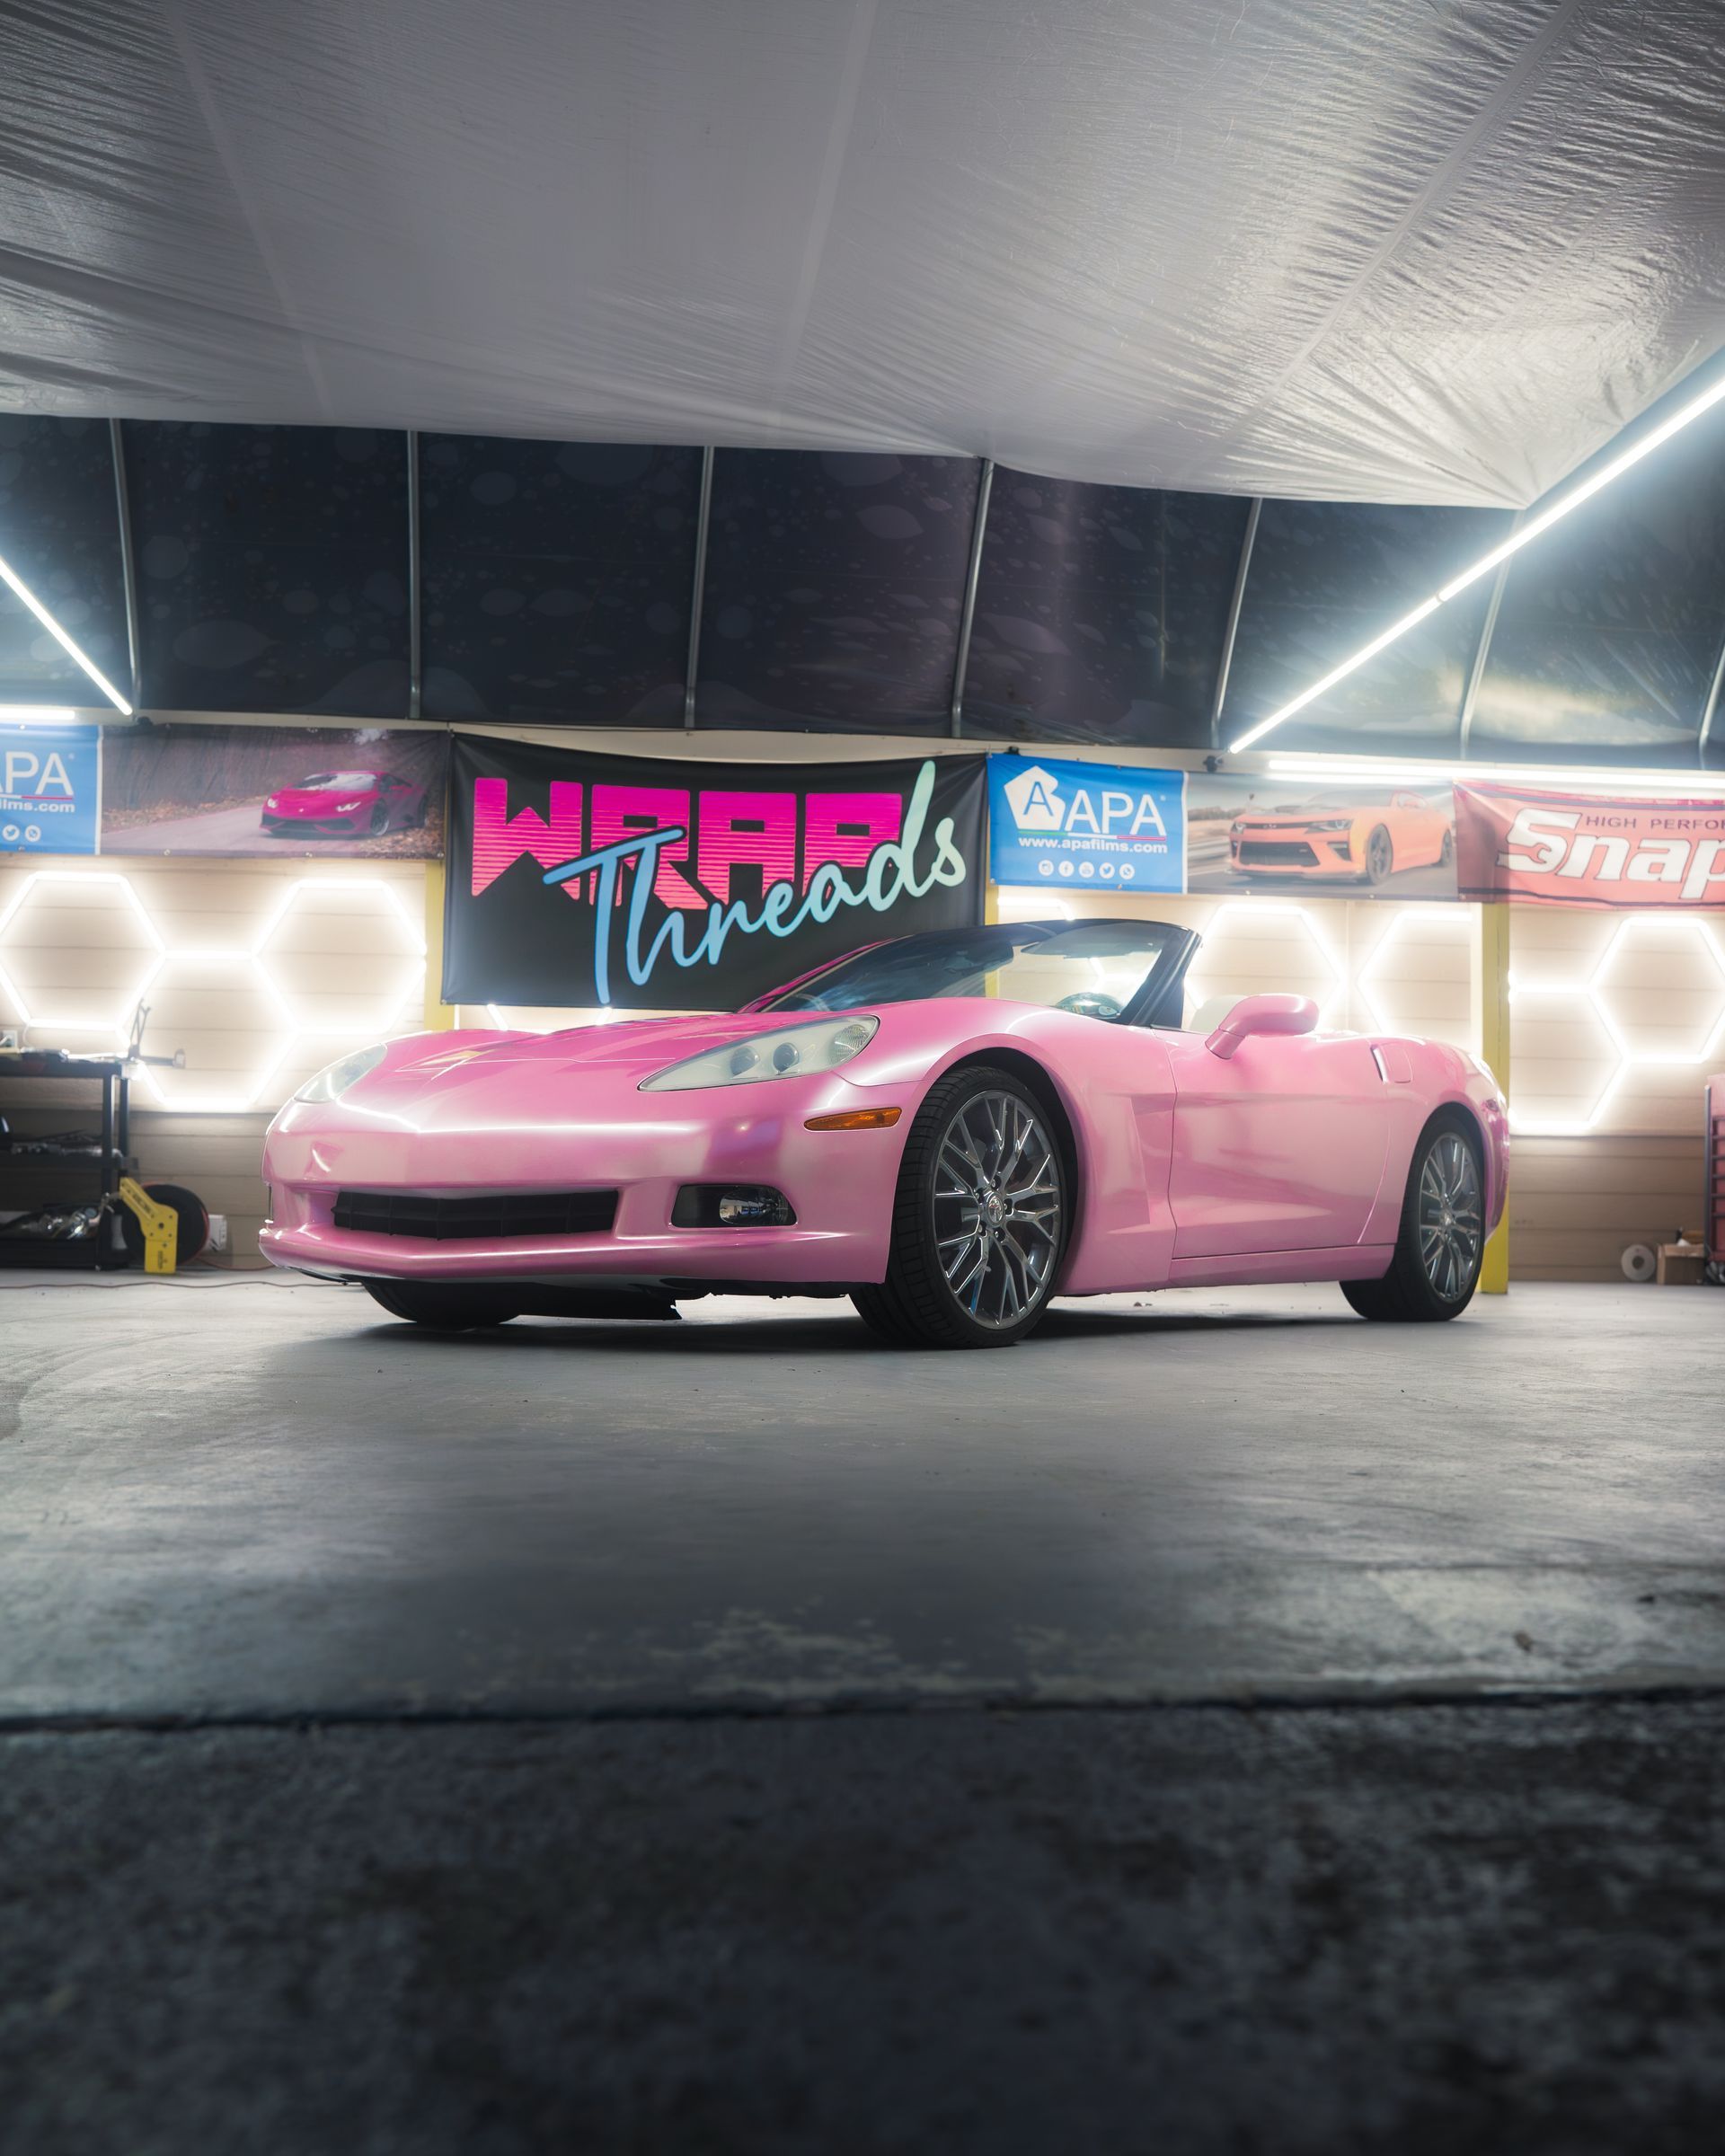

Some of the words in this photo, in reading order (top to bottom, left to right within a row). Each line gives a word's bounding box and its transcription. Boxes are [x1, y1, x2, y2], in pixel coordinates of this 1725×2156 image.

[0, 751, 75, 795] PA
[0, 798, 75, 813] lms.com
[1064, 789, 1167, 836] APA
[1586, 816, 1637, 828] HIGH
[472, 777, 903, 910] WRAP
[1018, 836, 1168, 853] www.apafilms.com
[543, 760, 967, 1005] Threads
